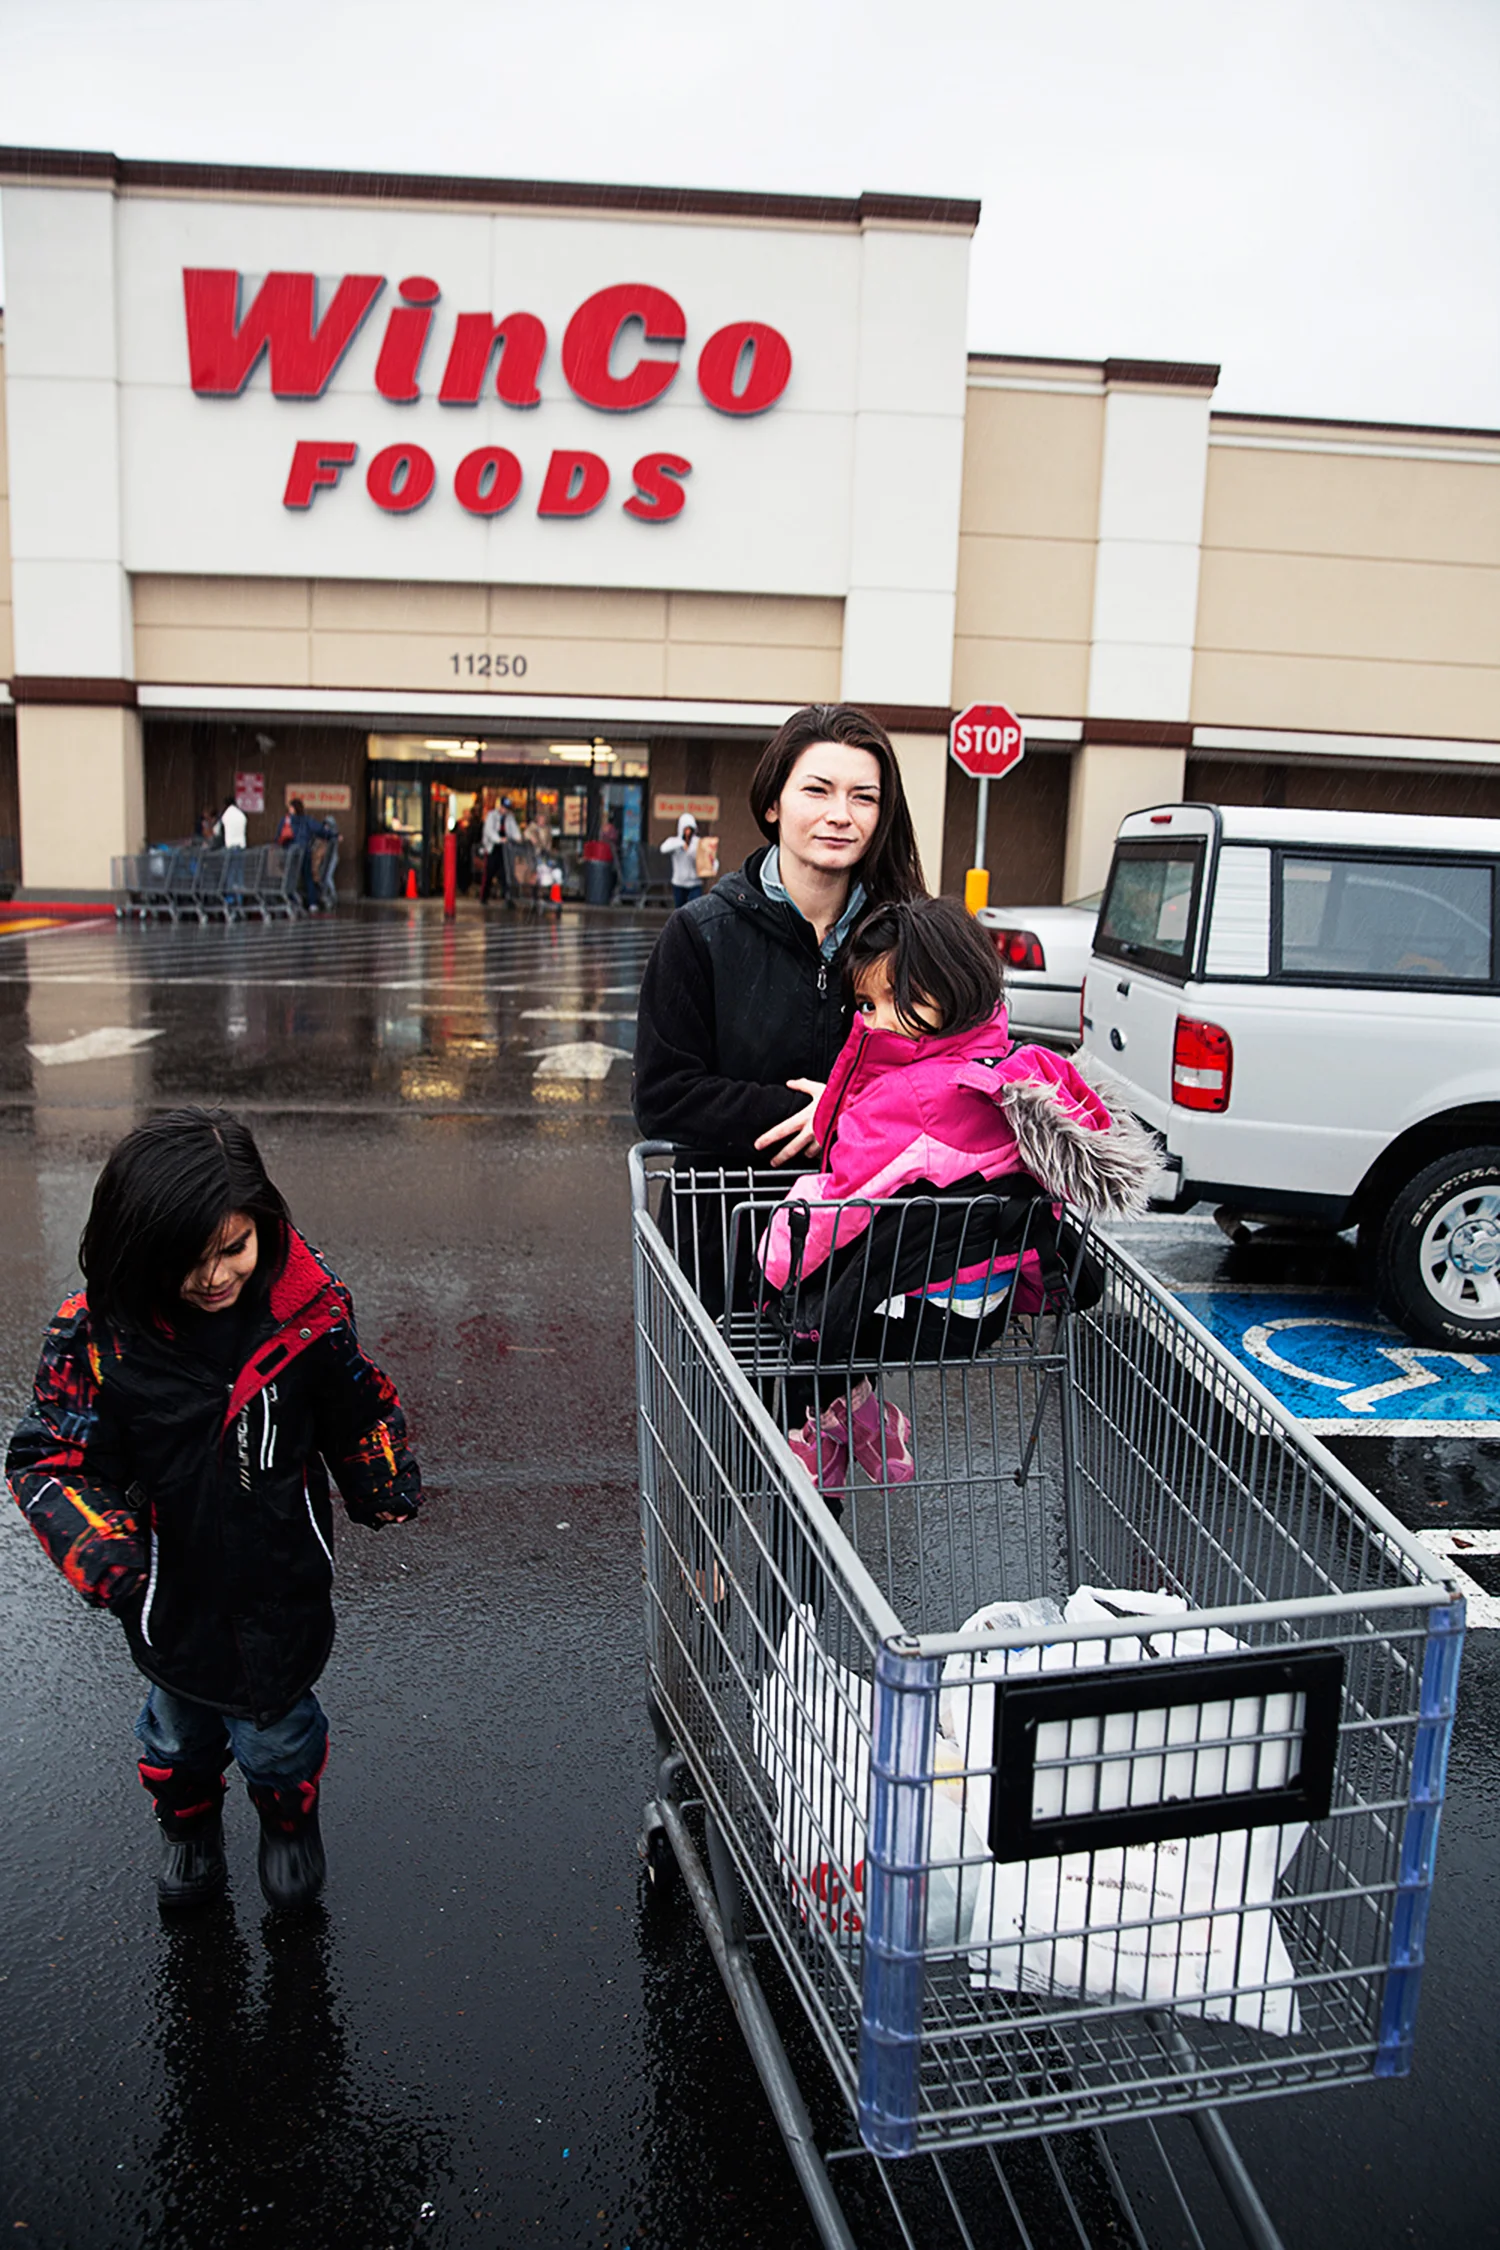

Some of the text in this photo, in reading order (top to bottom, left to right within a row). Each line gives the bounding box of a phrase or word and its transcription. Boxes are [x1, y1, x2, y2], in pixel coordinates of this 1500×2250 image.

[182, 267, 793, 415] WinCo
[282, 440, 692, 521] FOODS
[449, 652, 528, 677] 11250
[955, 724, 1019, 756] STOP
